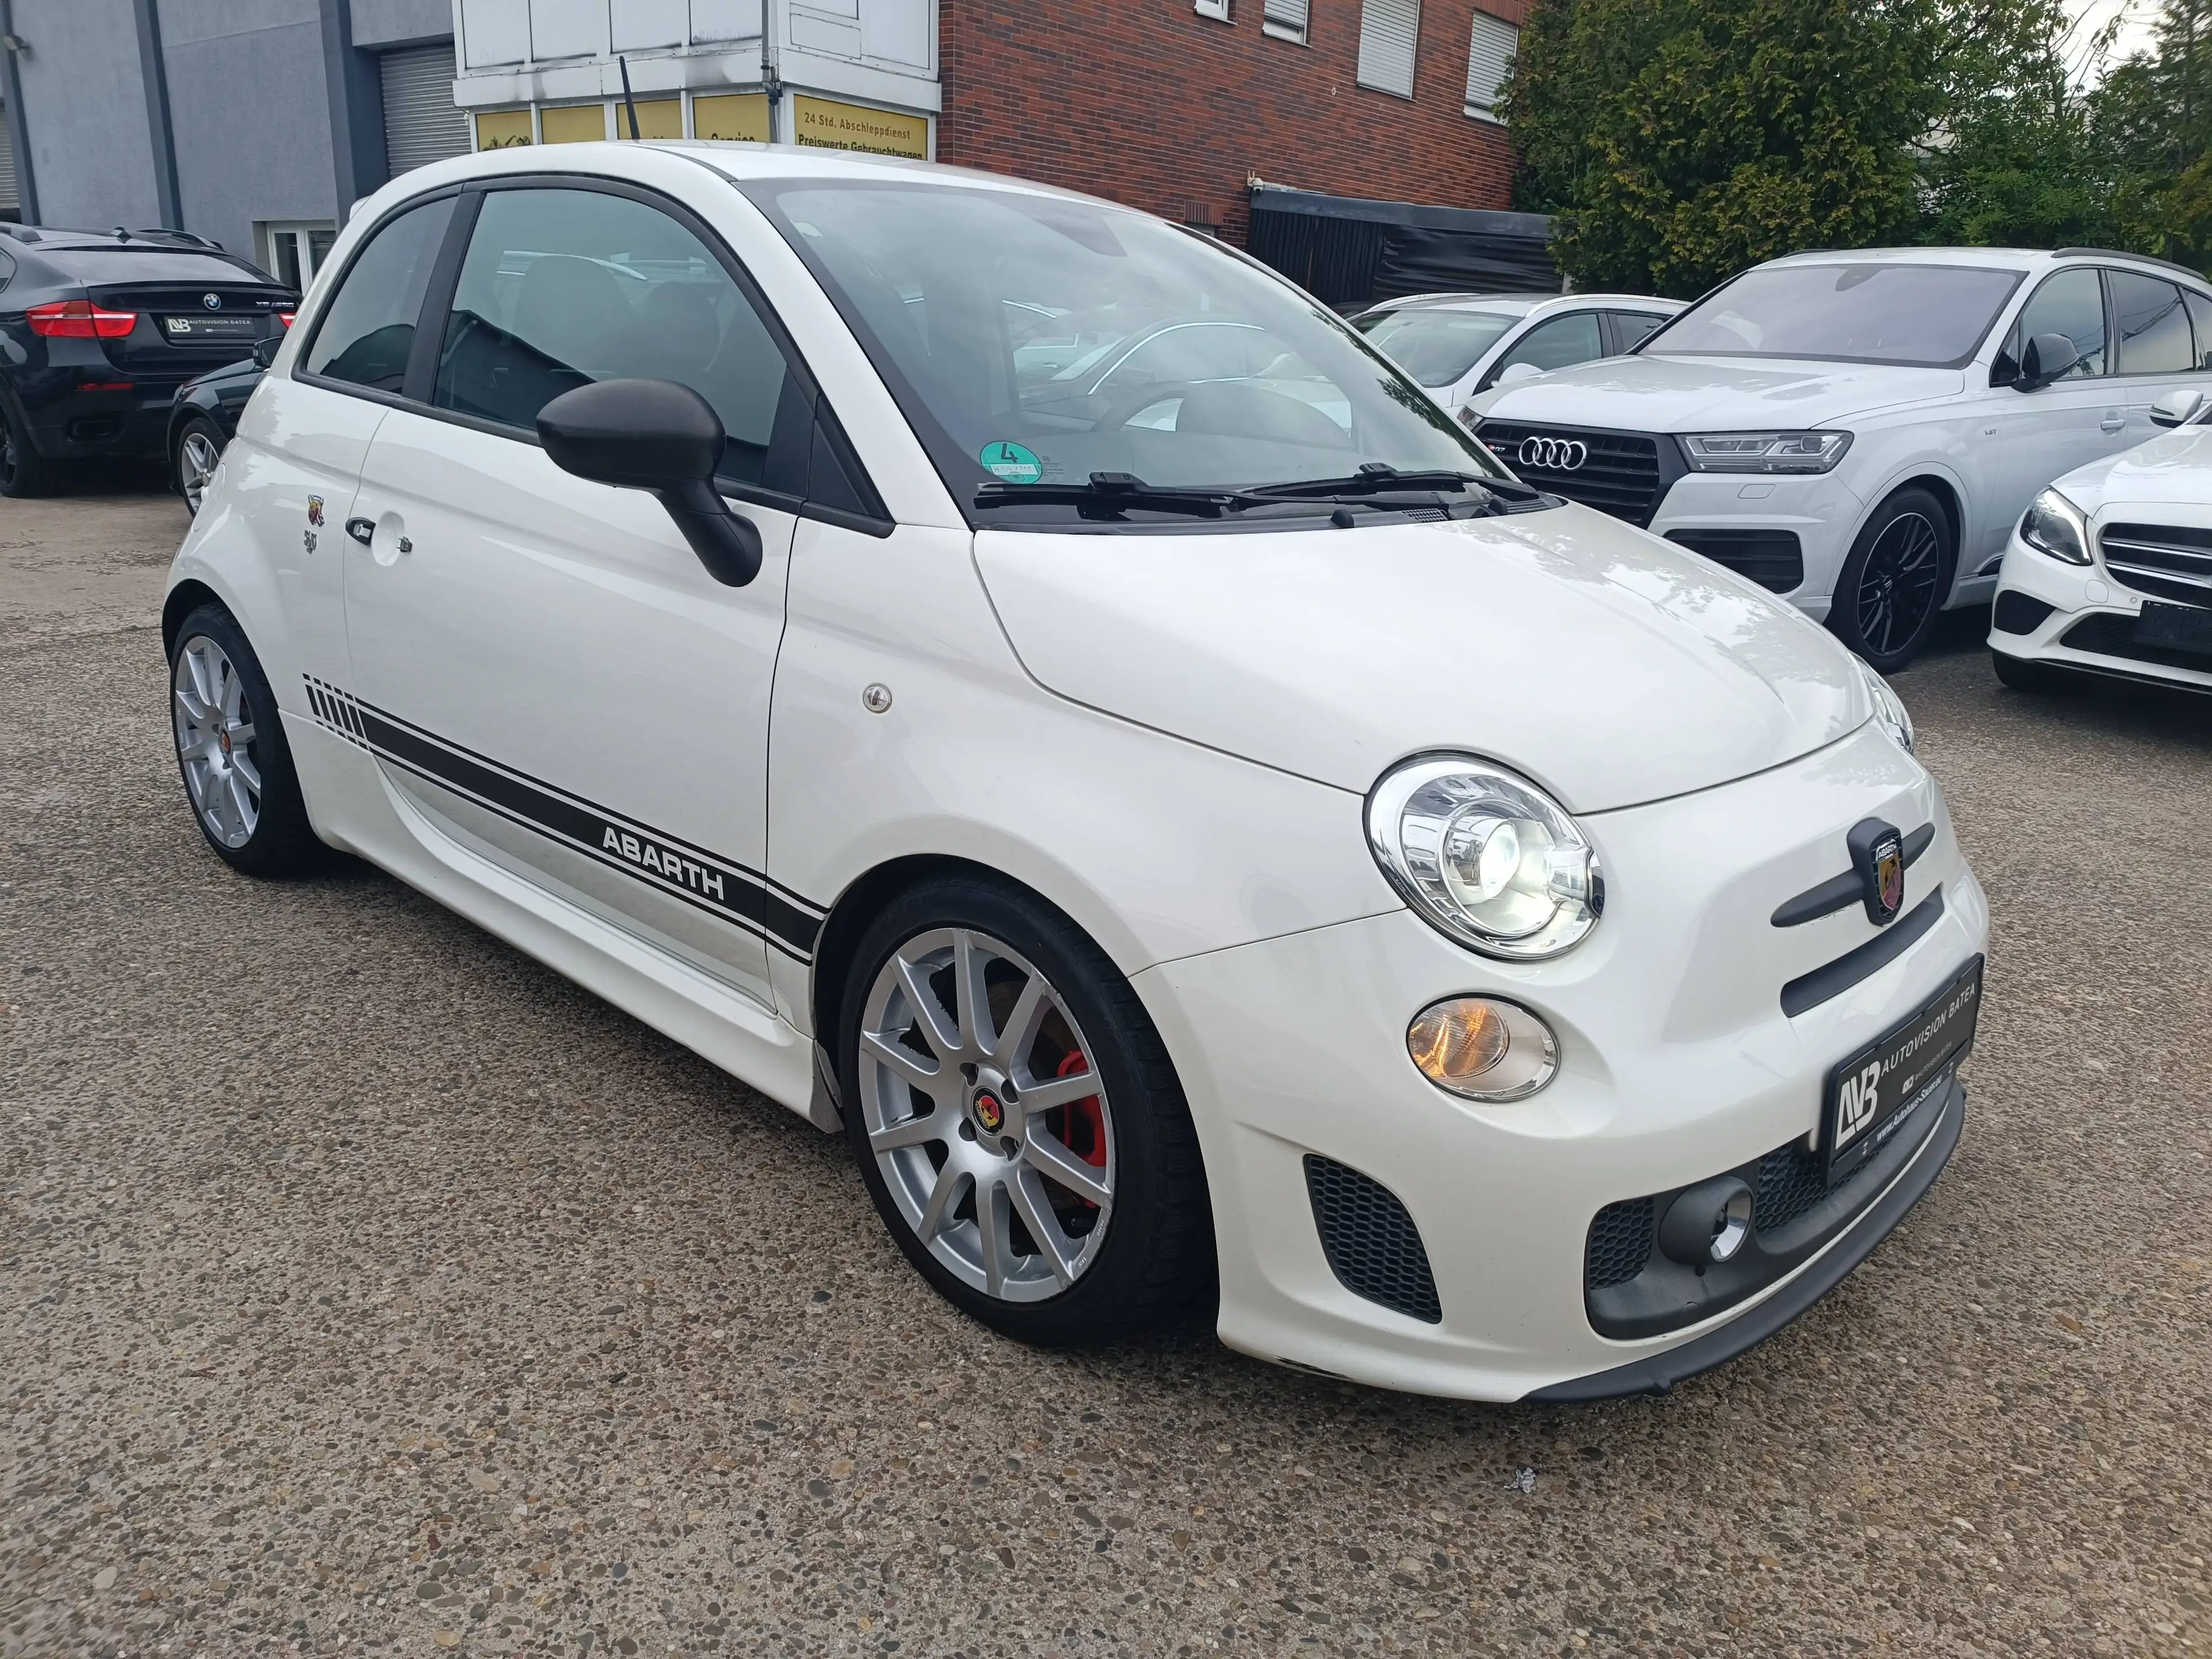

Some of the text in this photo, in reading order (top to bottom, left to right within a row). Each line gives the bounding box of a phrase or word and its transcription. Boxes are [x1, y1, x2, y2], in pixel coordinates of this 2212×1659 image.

[805, 112, 910, 140] 24 Std. Abschleppdienst
[798, 134, 849, 150] Preiswerte
[1001, 442, 1018, 463] 4
[1878, 843, 1897, 858] ABARTH
[602, 826, 725, 901] ABARTH
[1881, 1009, 1947, 1077] AUTOVISION
[1948, 982, 1975, 1018] BATEA
